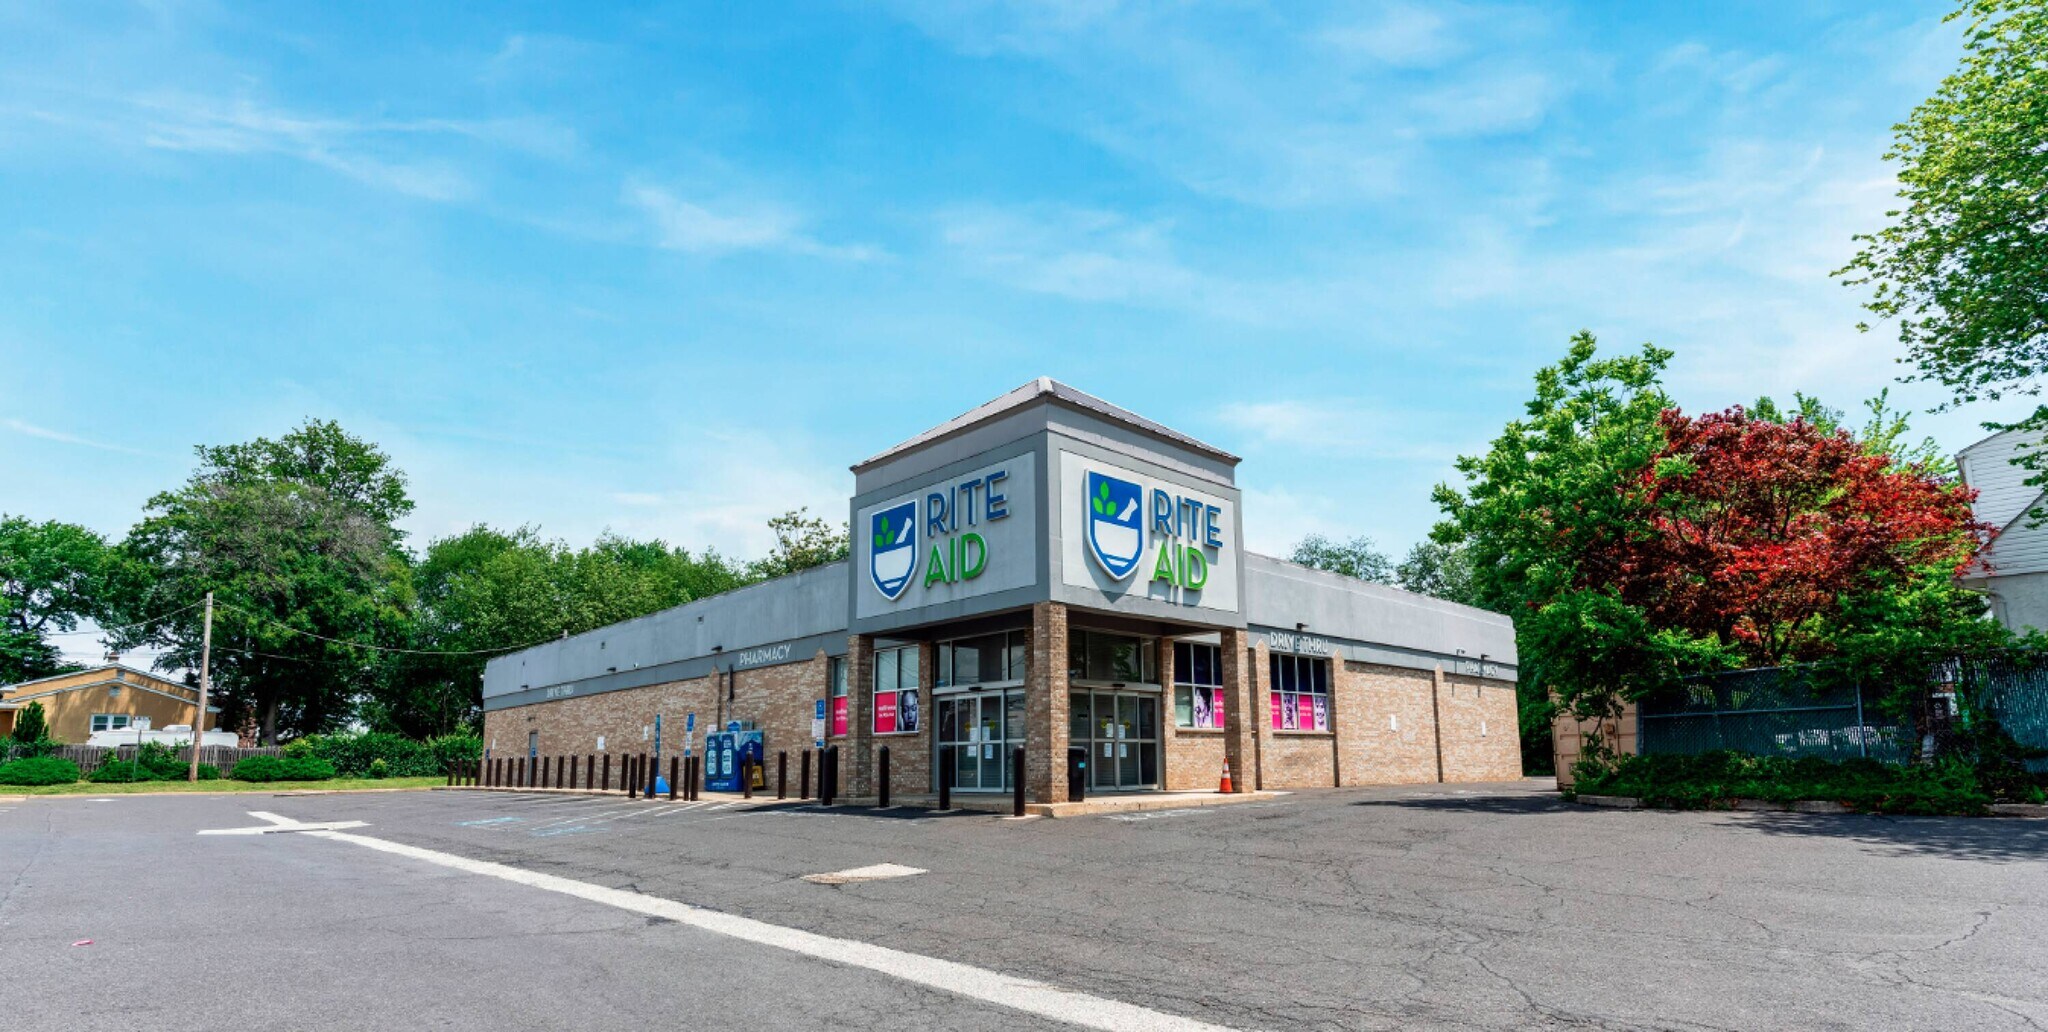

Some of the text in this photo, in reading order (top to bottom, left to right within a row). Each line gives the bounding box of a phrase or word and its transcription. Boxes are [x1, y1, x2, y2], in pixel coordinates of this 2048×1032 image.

[927, 469, 1008, 537] RITE
[1150, 487, 1223, 548] RITE
[924, 532, 986, 588] AID
[1153, 541, 1208, 590] AID
[739, 643, 791, 665] PHARMACY
[1270, 631, 1328, 653] DRIVE THRU
